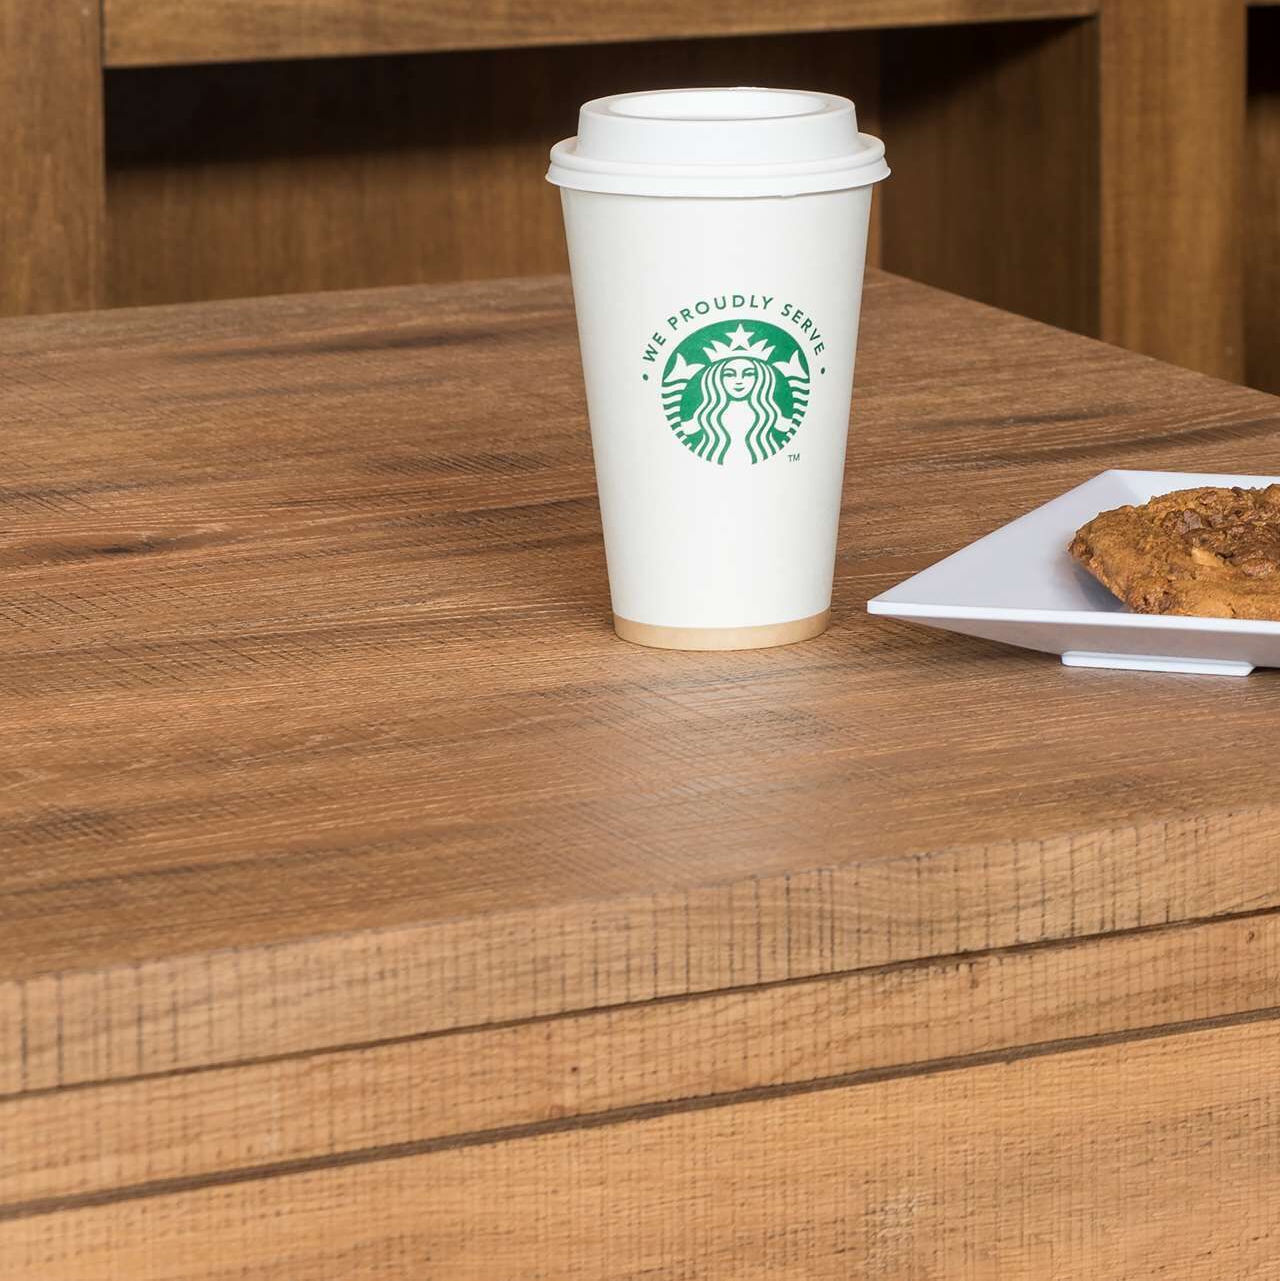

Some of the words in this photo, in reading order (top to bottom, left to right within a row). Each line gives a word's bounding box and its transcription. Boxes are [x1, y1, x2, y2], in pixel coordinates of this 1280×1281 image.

[642, 332, 667, 363] WE
[667, 294, 774, 331] PROUDLY
[780, 303, 825, 356] SERVE
[787, 453, 801, 463] TM
